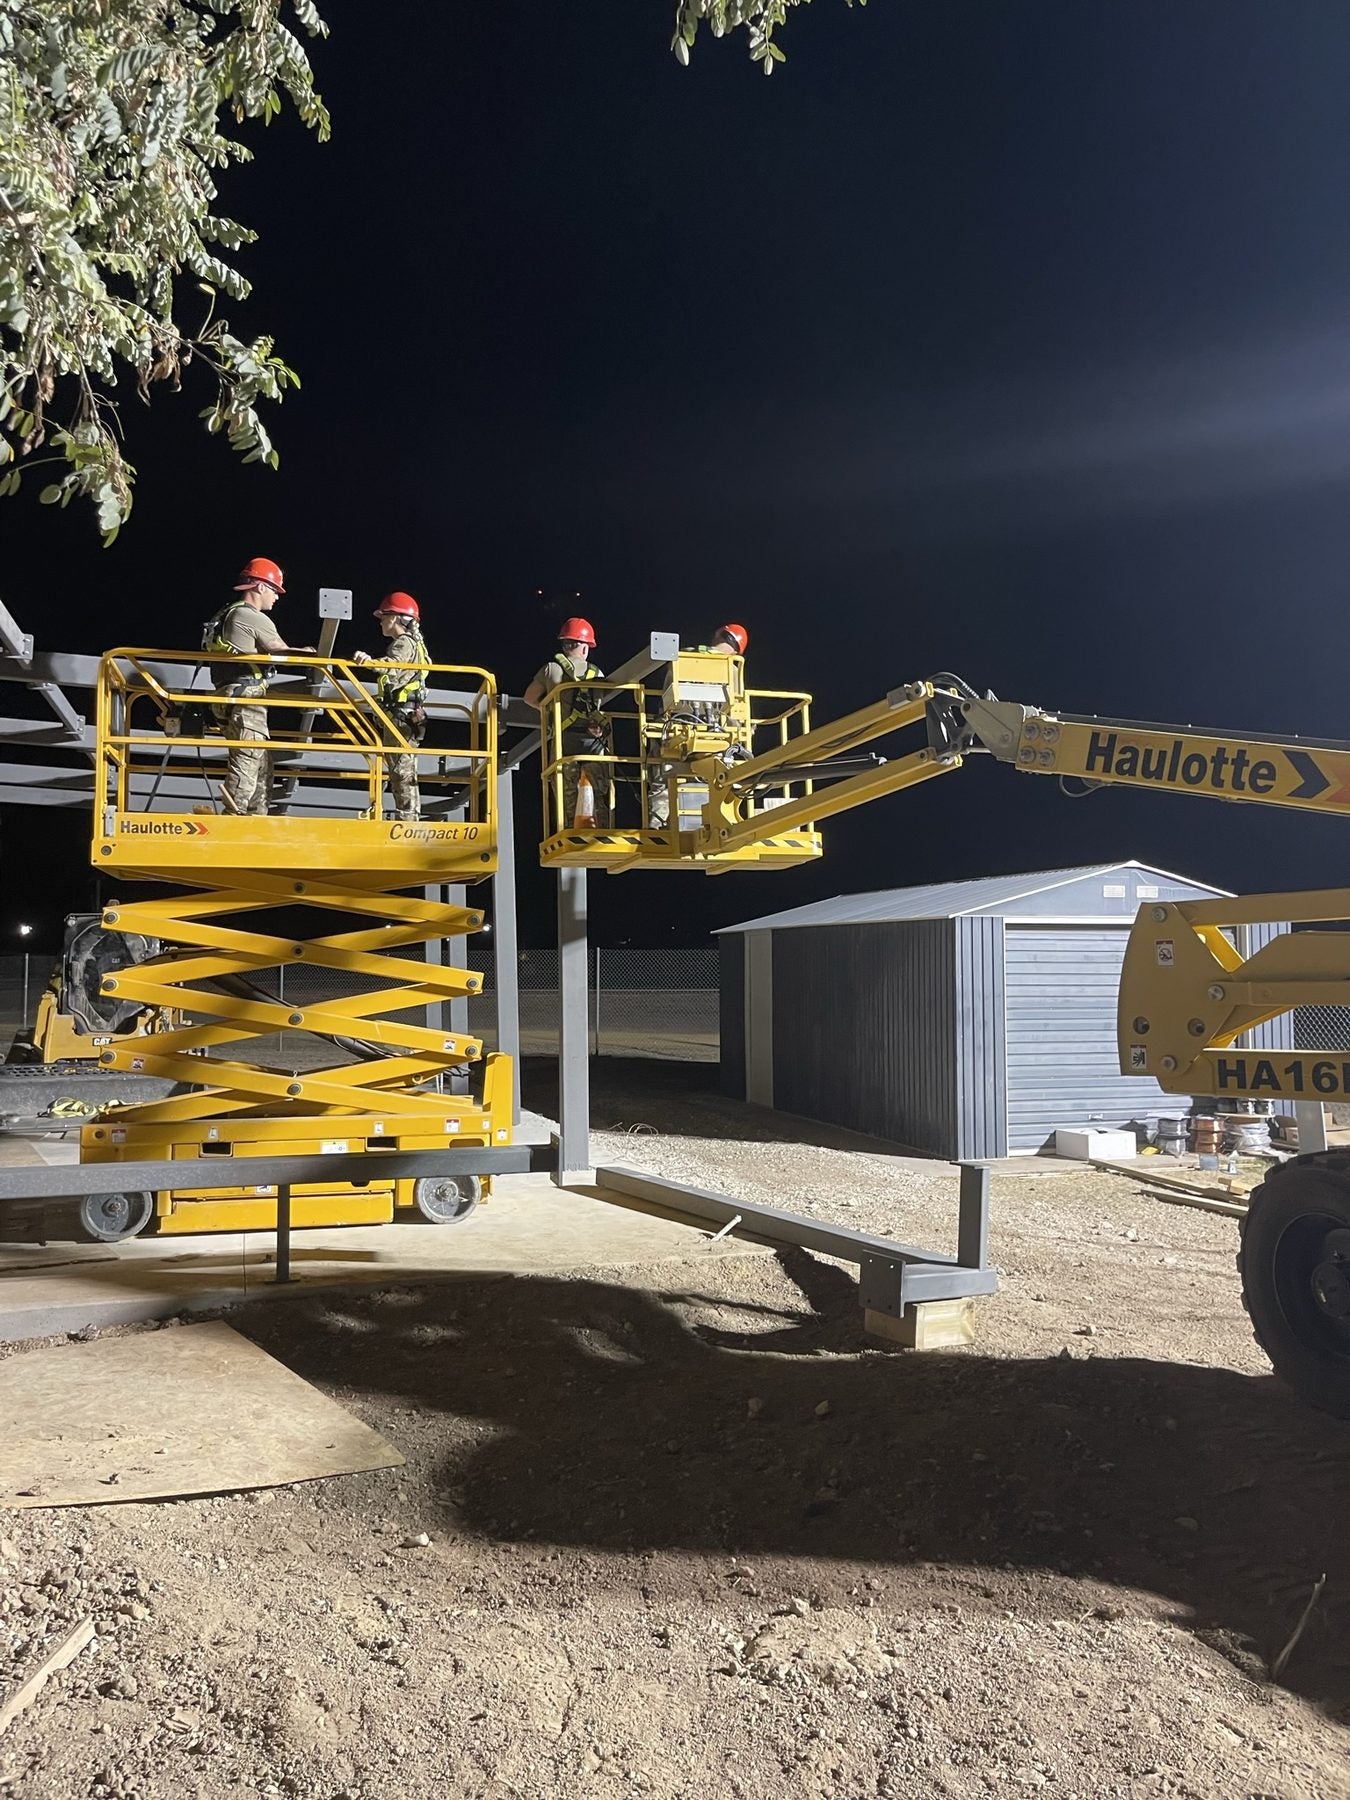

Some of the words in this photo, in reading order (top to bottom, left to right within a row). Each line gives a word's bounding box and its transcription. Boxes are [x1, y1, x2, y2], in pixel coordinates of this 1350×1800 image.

[1085, 731, 1277, 794] Haulotte
[120, 820, 183, 835] Haulotte
[389, 823, 459, 842] Compact
[463, 826, 479, 840] 10
[93, 1037, 111, 1046] CAT
